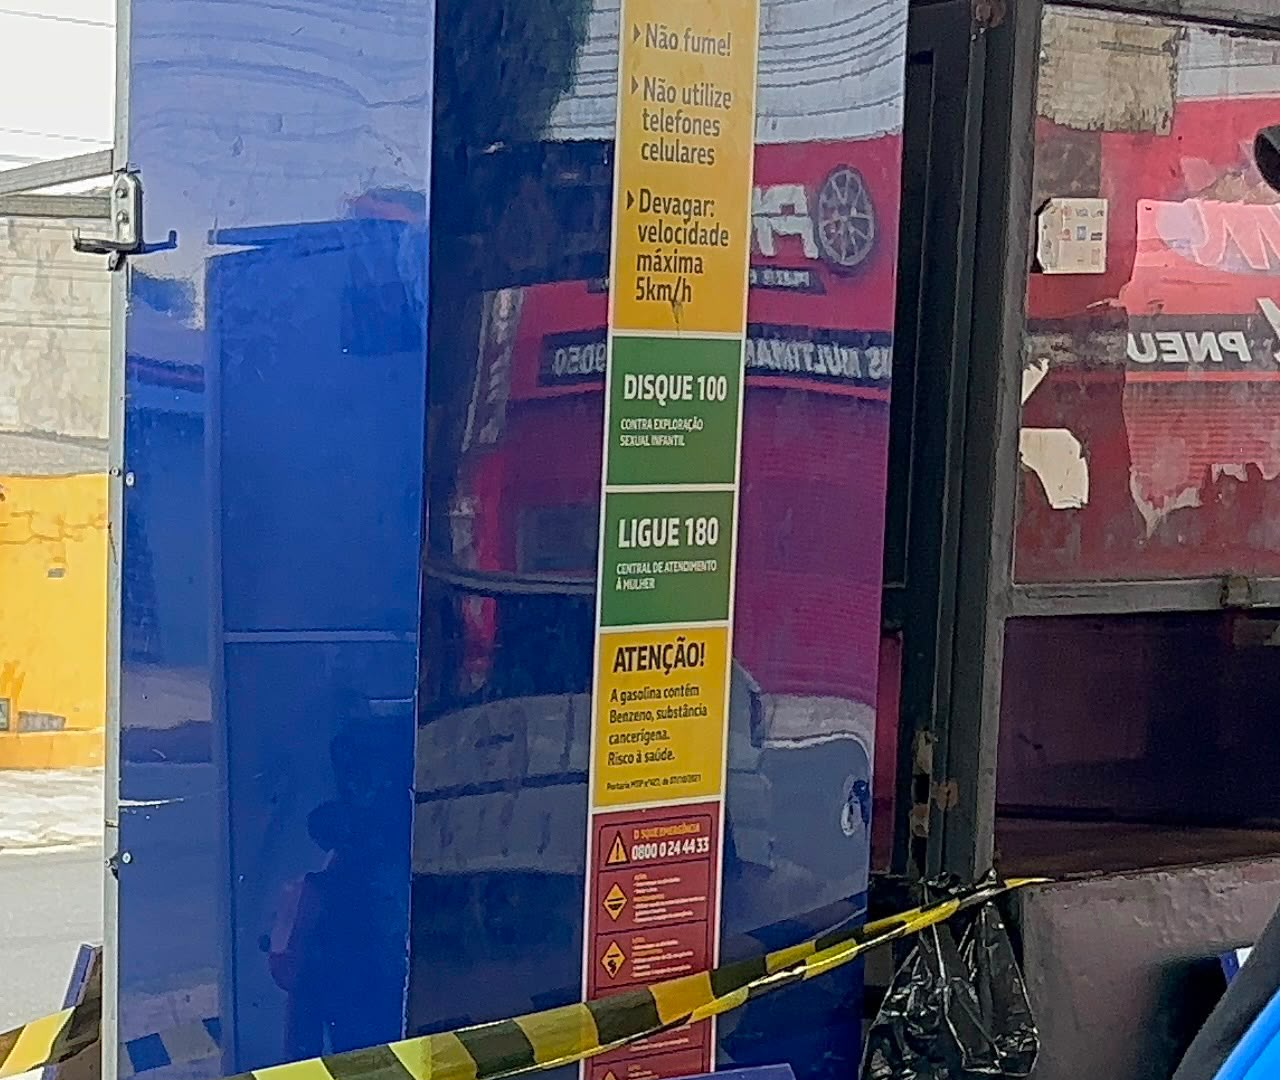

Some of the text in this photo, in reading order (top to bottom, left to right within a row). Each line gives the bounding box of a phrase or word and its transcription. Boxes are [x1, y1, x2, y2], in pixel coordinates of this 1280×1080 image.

[645, 23, 732, 56] Não fume!
[643, 76, 732, 110] Não utilize
[642, 108, 721, 137] telefones
[641, 138, 715, 165] celulares
[638, 188, 715, 222] Devagar:
[637, 219, 730, 247] velocidade
[636, 248, 704, 275] máxima
[635, 276, 692, 303] 5km/h
[624, 374, 728, 406] DISQUE 100
[620, 416, 704, 433] CONTRA EXPLORAÇÃO
[620, 434, 685, 447] SEXUAL INFANTIL
[618, 517, 719, 549] LIGUE 180
[616, 559, 717, 575] CENTRAL DE ATENDIMENTO
[622, 578, 656, 590] MULHER
[612, 636, 706, 675] ATENÇÃO!
[610, 683, 700, 706] A gasolina contém
[609, 703, 708, 724] Benzeno, substância
[608, 728, 671, 746] cancerígena.
[607, 751, 635, 766] Risco
[644, 747, 676, 763] saúde.
[631, 841, 658, 861] 0800
